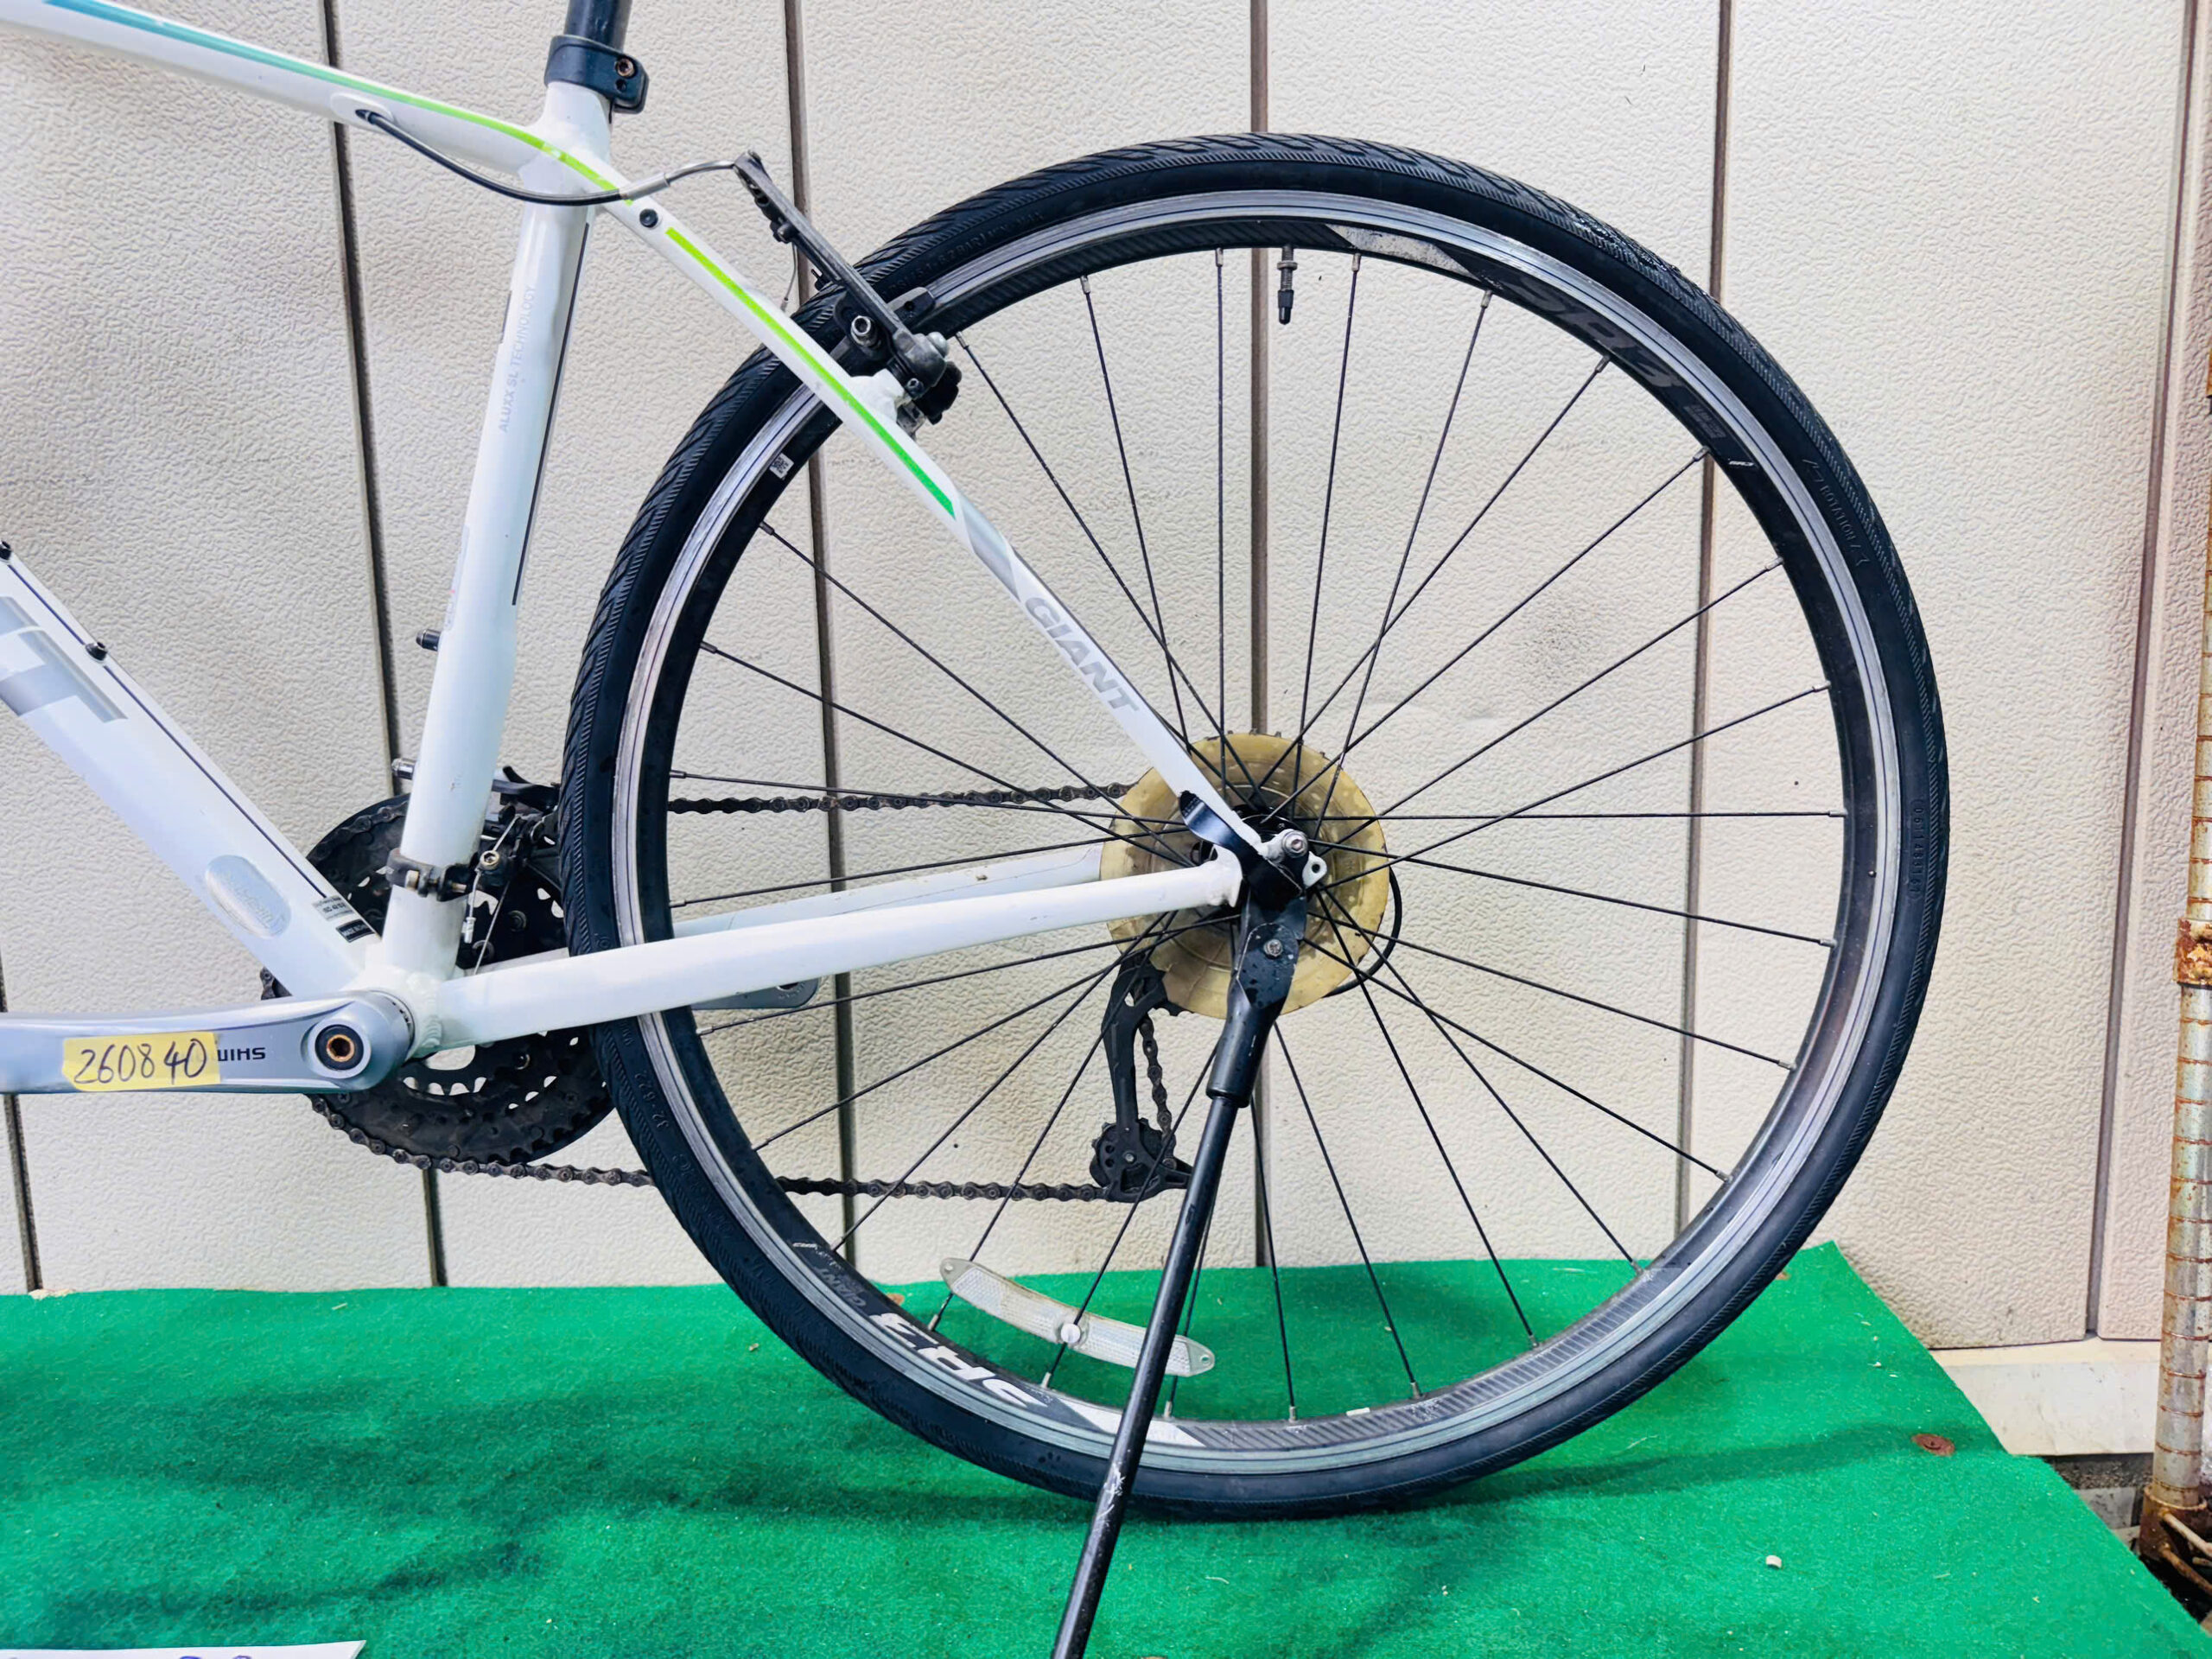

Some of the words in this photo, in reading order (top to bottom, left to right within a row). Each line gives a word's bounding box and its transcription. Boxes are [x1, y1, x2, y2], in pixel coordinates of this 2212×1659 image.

[511, 284, 537, 368] TECHNOLOGY
[508, 372, 521, 389] SL
[498, 388, 517, 433] ALUXX
[1025, 596, 1140, 712] GIANT
[73, 1038, 207, 1085] 260840
